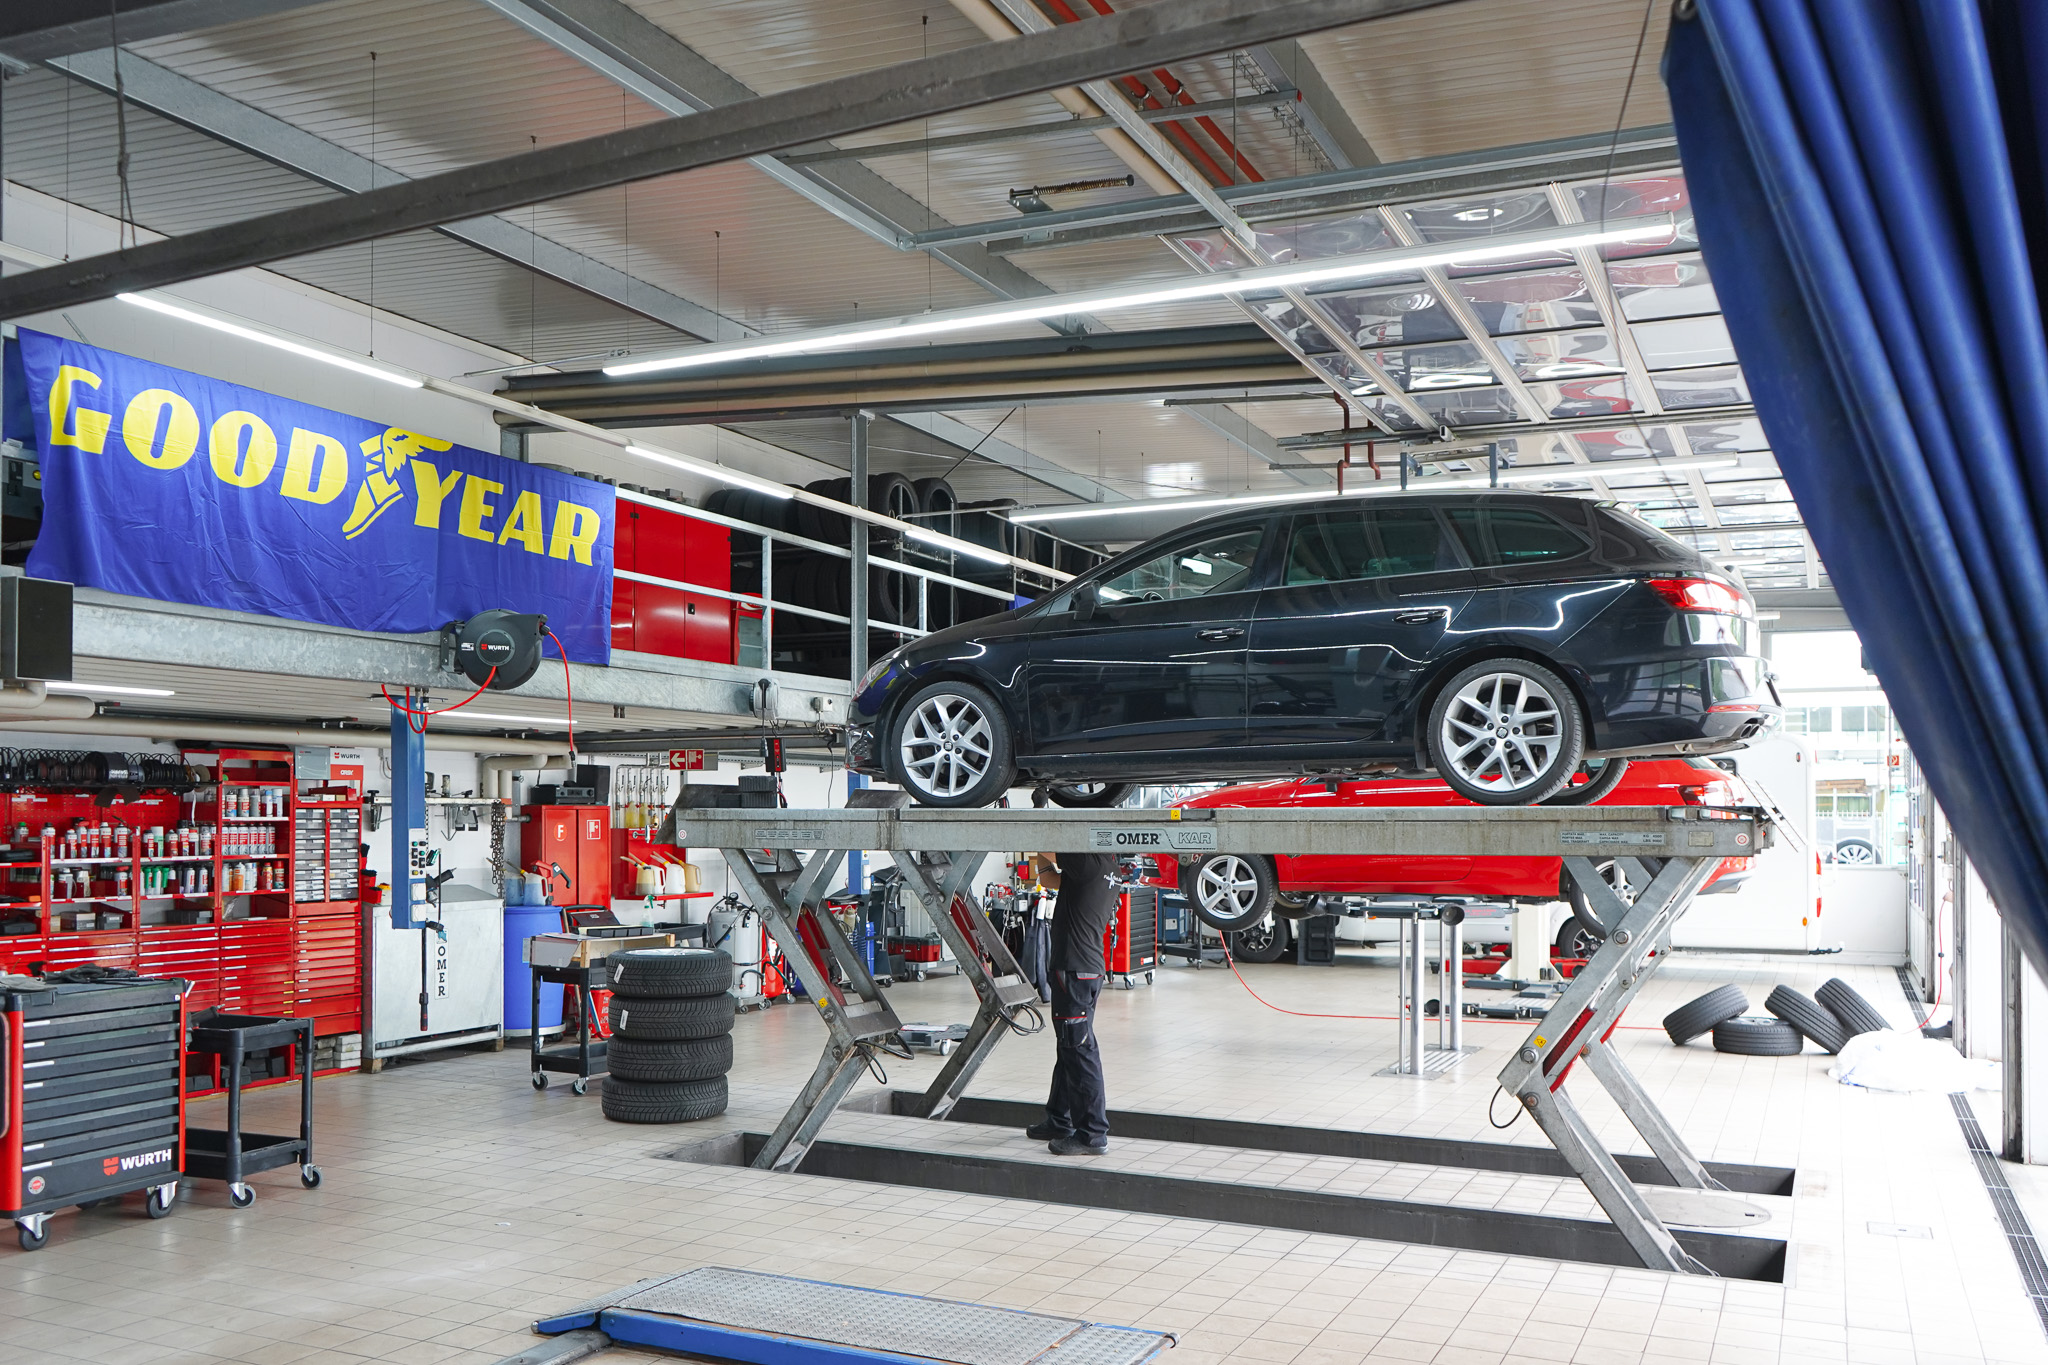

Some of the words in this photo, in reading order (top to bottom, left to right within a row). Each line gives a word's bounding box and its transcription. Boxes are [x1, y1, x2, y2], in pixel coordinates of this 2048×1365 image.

[557, 824, 564, 838] F
[1116, 833, 1160, 845] OMER
[1178, 832, 1212, 844] KAR
[436, 945, 447, 997] OMER
